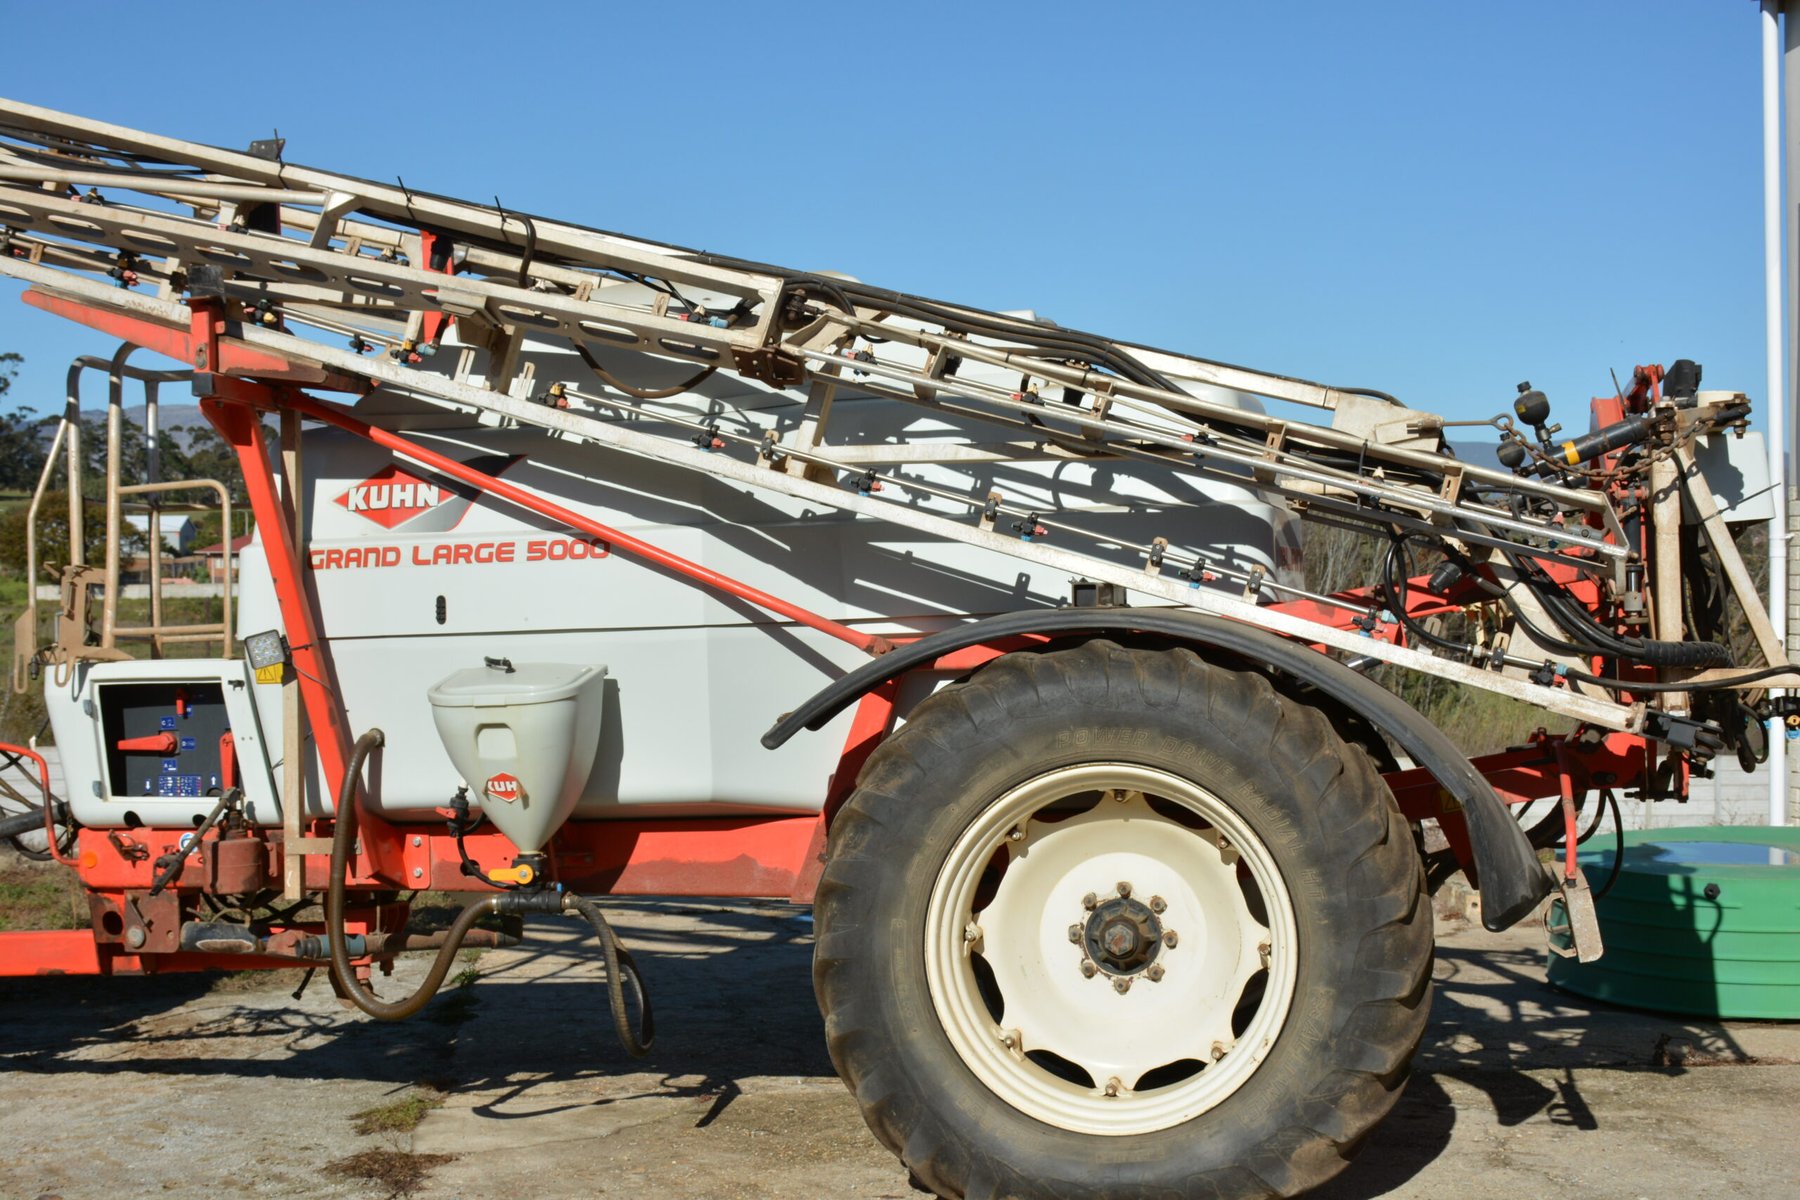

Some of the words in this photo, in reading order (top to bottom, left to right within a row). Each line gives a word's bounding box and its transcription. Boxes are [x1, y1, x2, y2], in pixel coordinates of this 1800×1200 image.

[347, 483, 439, 511] KUHN
[307, 547, 401, 570] GRAND
[412, 542, 515, 566] LARGE
[527, 538, 610, 561] 5000
[487, 780, 518, 792] KUH
[1056, 727, 1150, 748] POWER
[1160, 735, 1236, 778] DRIVE
[1240, 780, 1304, 856] RADIAL
